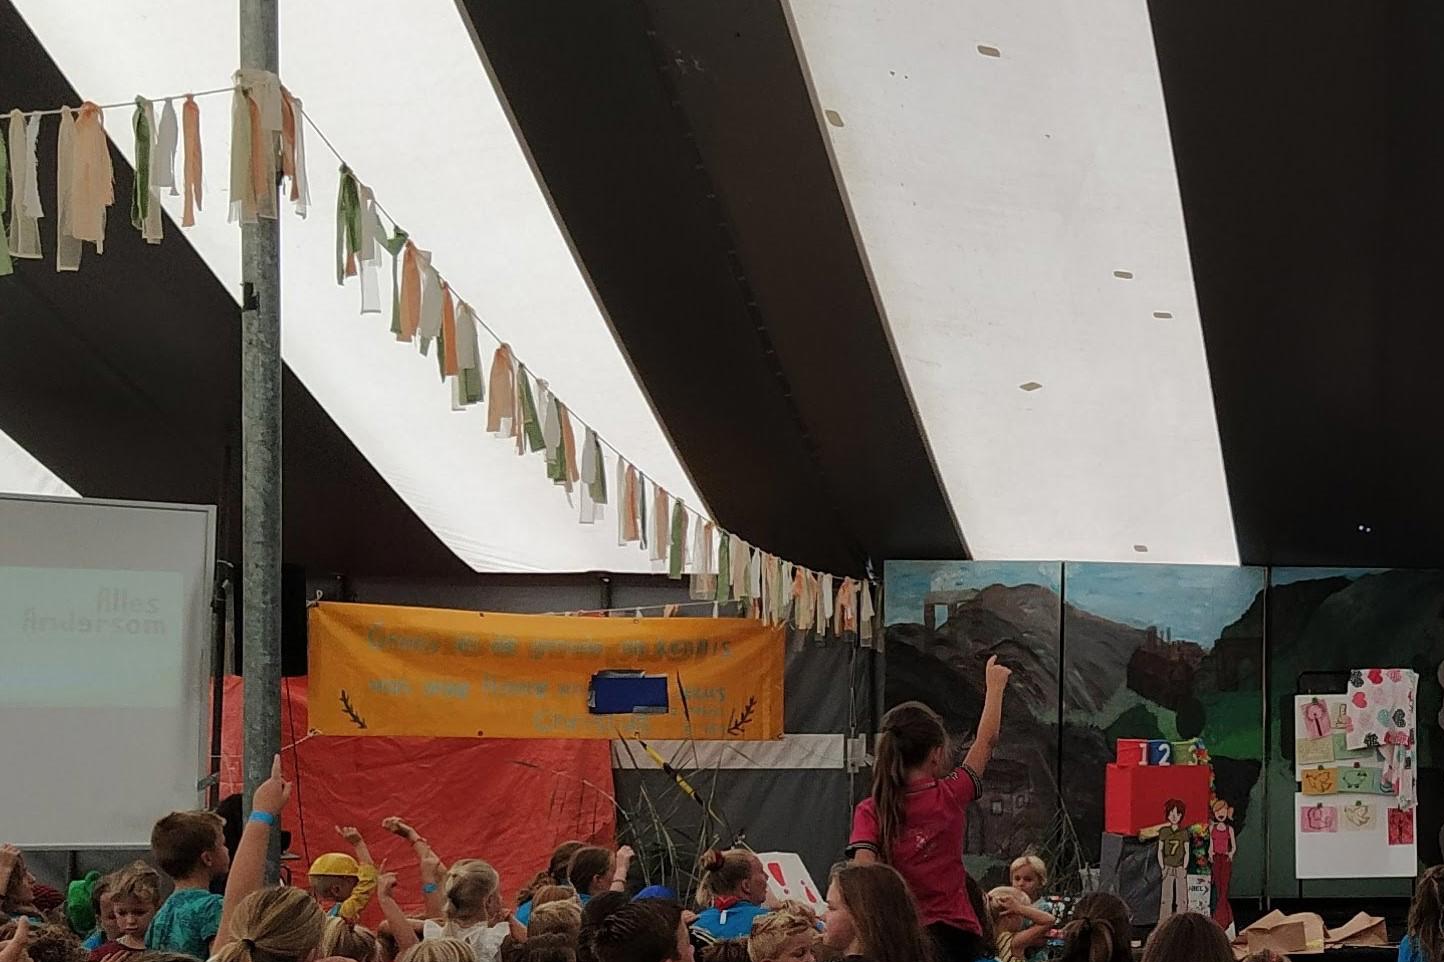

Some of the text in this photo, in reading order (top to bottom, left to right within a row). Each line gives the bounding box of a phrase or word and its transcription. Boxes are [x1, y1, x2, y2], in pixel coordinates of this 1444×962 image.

[1139, 743, 1148, 766] 1
[1158, 743, 1170, 766] 2
[1169, 840, 1180, 856] 7
